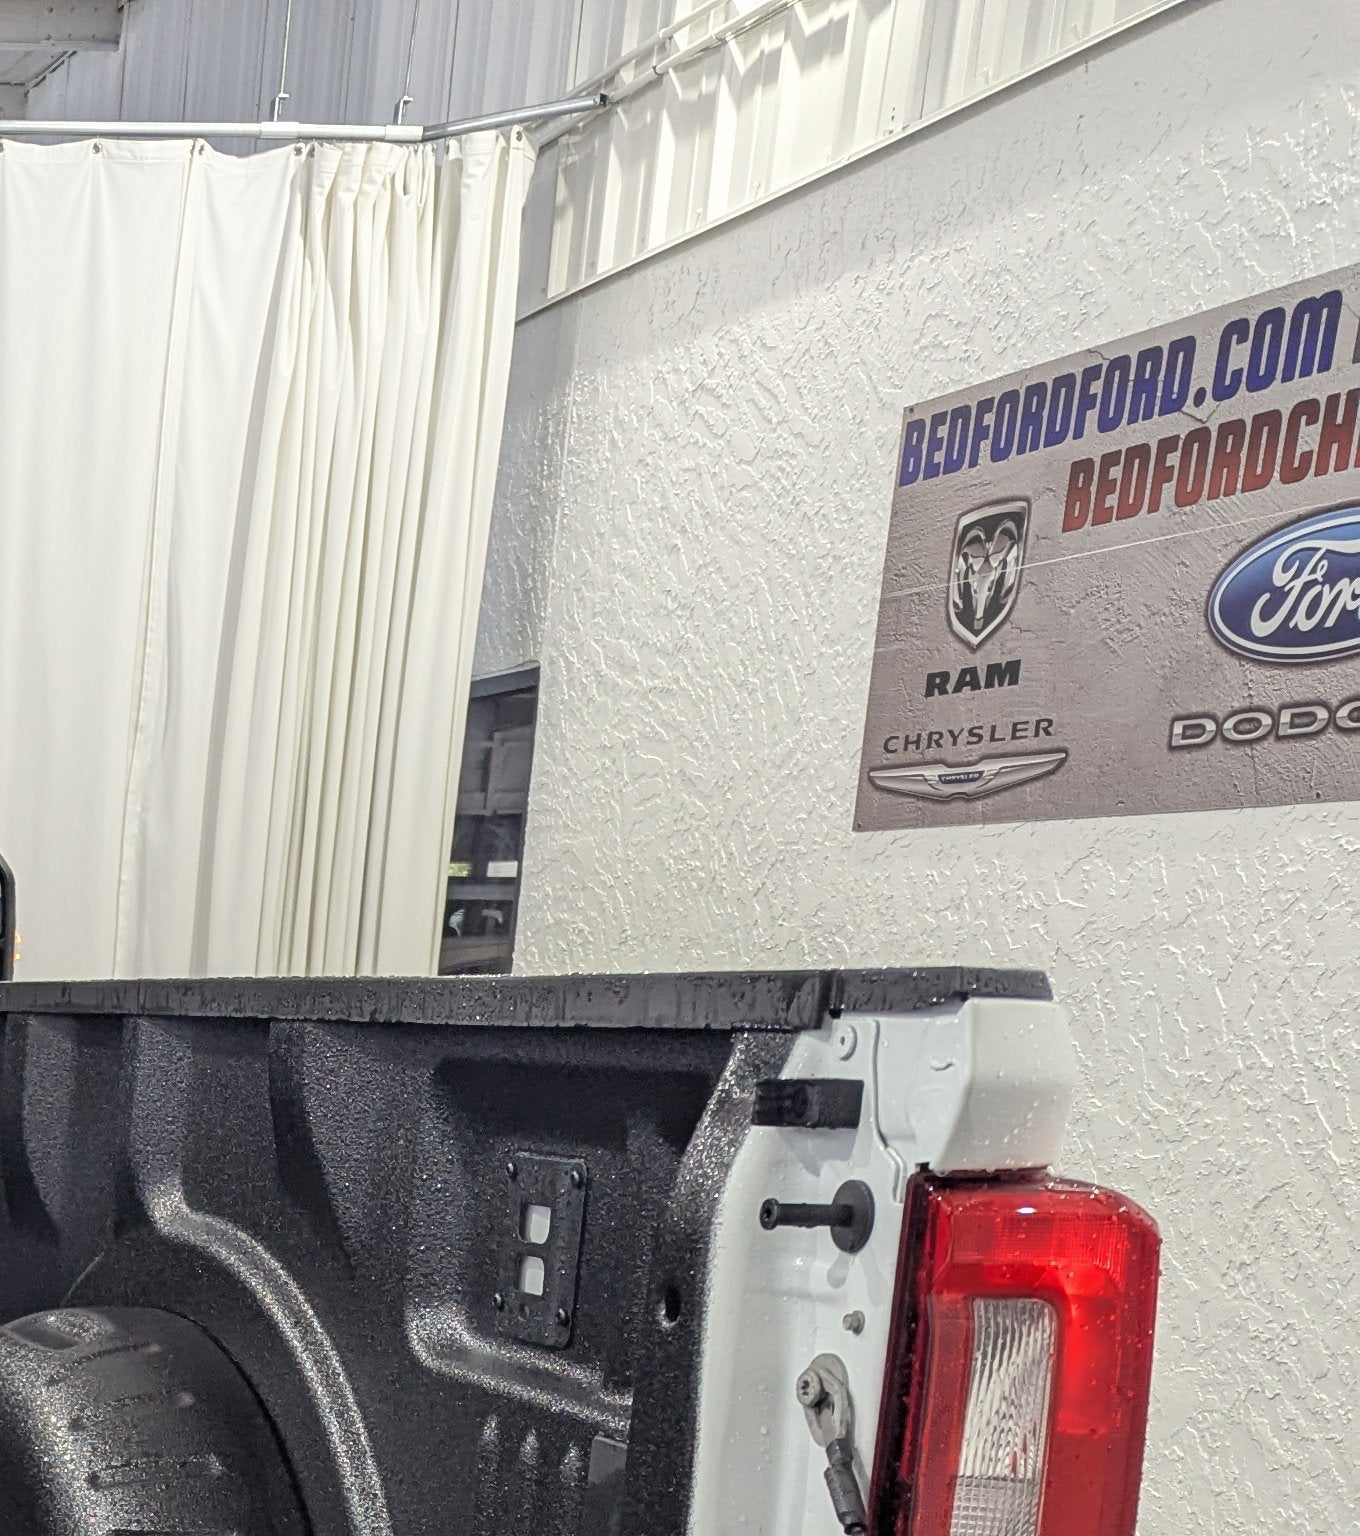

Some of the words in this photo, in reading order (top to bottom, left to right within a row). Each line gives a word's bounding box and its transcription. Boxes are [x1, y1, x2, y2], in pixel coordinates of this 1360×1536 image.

[899, 289, 1344, 488] BEDFORDFORD.COM
[1061, 388, 1360, 534] BEDFORDCH
[1250, 539, 1360, 638] For
[924, 658, 1022, 699] RAM
[883, 718, 1054, 754] CHRYSLER
